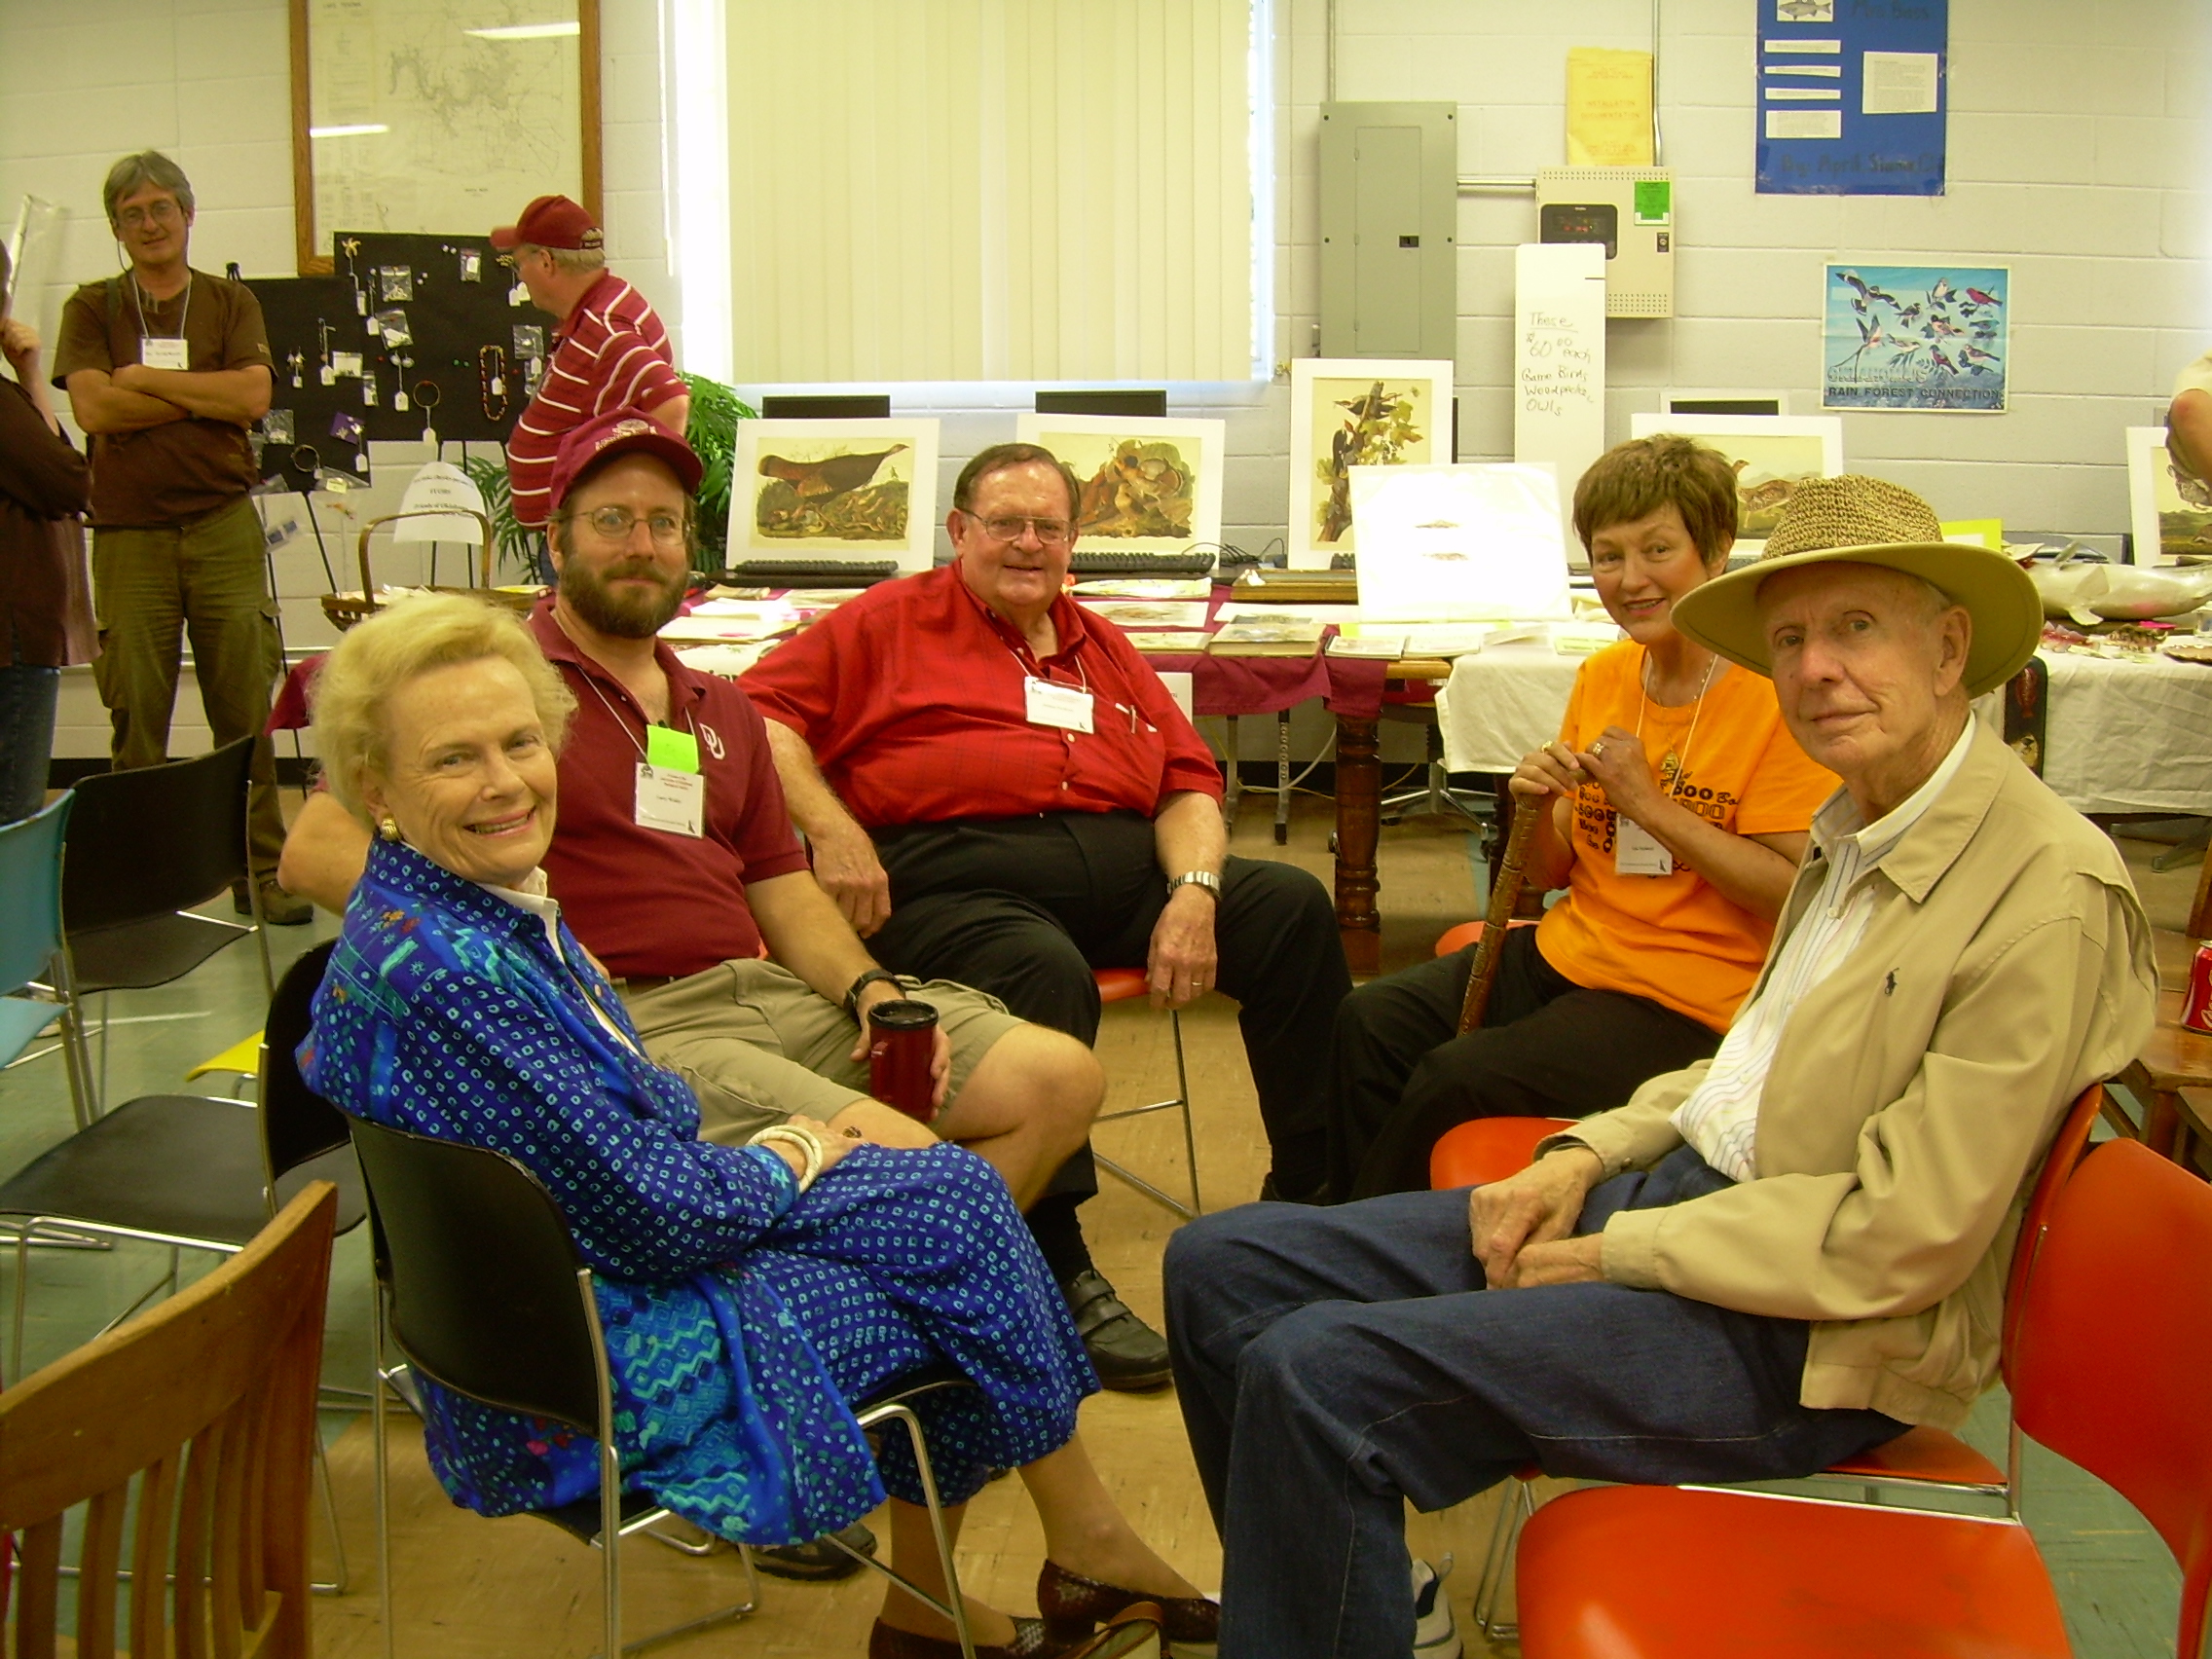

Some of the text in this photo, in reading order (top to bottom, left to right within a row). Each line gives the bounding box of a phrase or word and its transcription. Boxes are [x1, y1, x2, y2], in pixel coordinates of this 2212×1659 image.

[1828, 387, 2000, 400] RAIN FOREST CONNECTION
